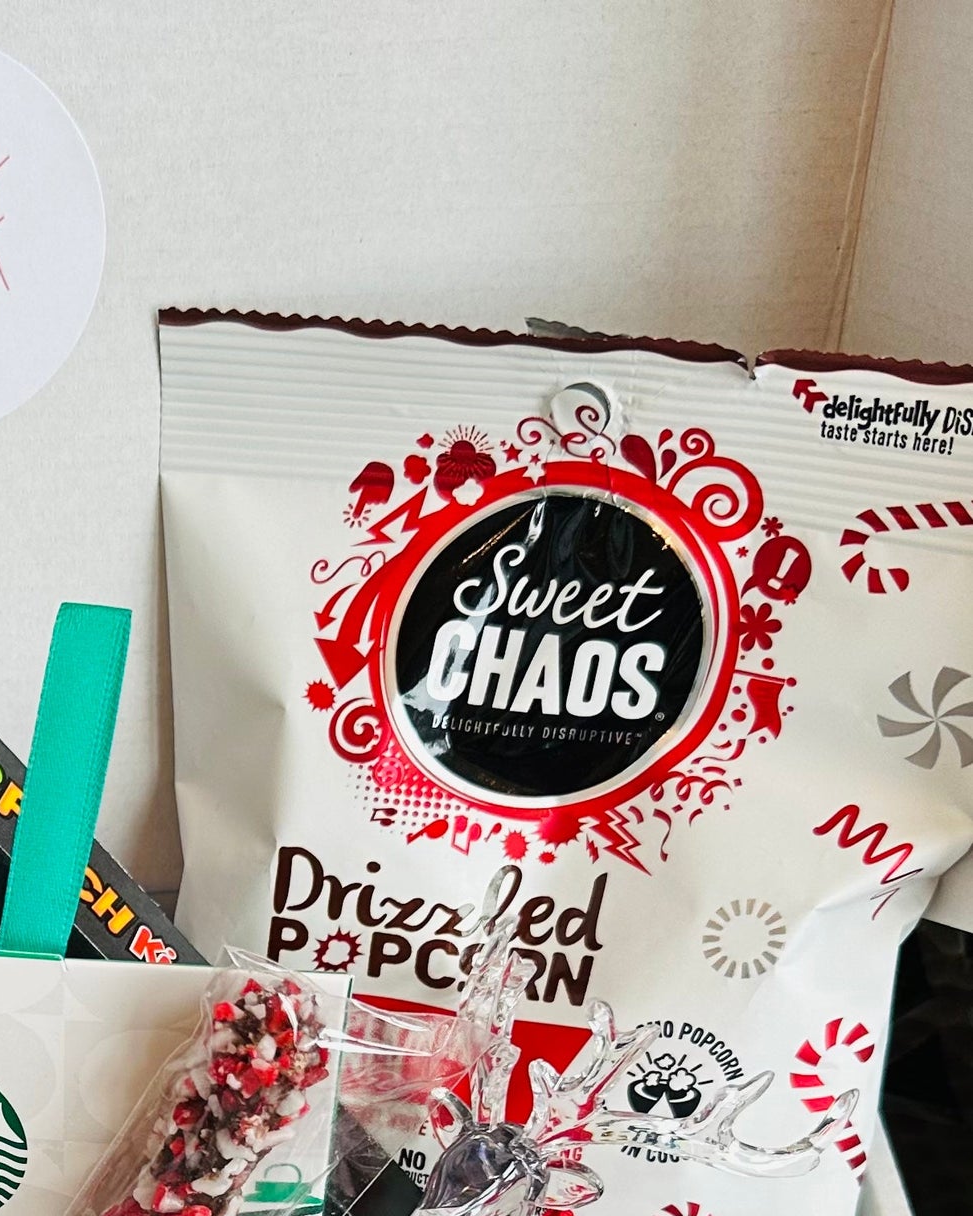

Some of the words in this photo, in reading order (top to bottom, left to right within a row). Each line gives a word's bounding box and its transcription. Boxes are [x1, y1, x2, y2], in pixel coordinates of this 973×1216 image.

[820, 421, 858, 442] taste
[863, 428, 908, 449] starts
[913, 433, 954, 455] here!
[823, 395, 941, 436] delightfully
[453, 544, 666, 632] Sweet
[426, 619, 666, 720] CHAOS
[432, 714, 534, 739] DELIGHTFULLY
[542, 726, 633, 745] DISRUPTIVE
[274, 846, 608, 951] Drizzled
[678, 1021, 744, 1081] POPCORN
[398, 1148, 426, 1171] NO
